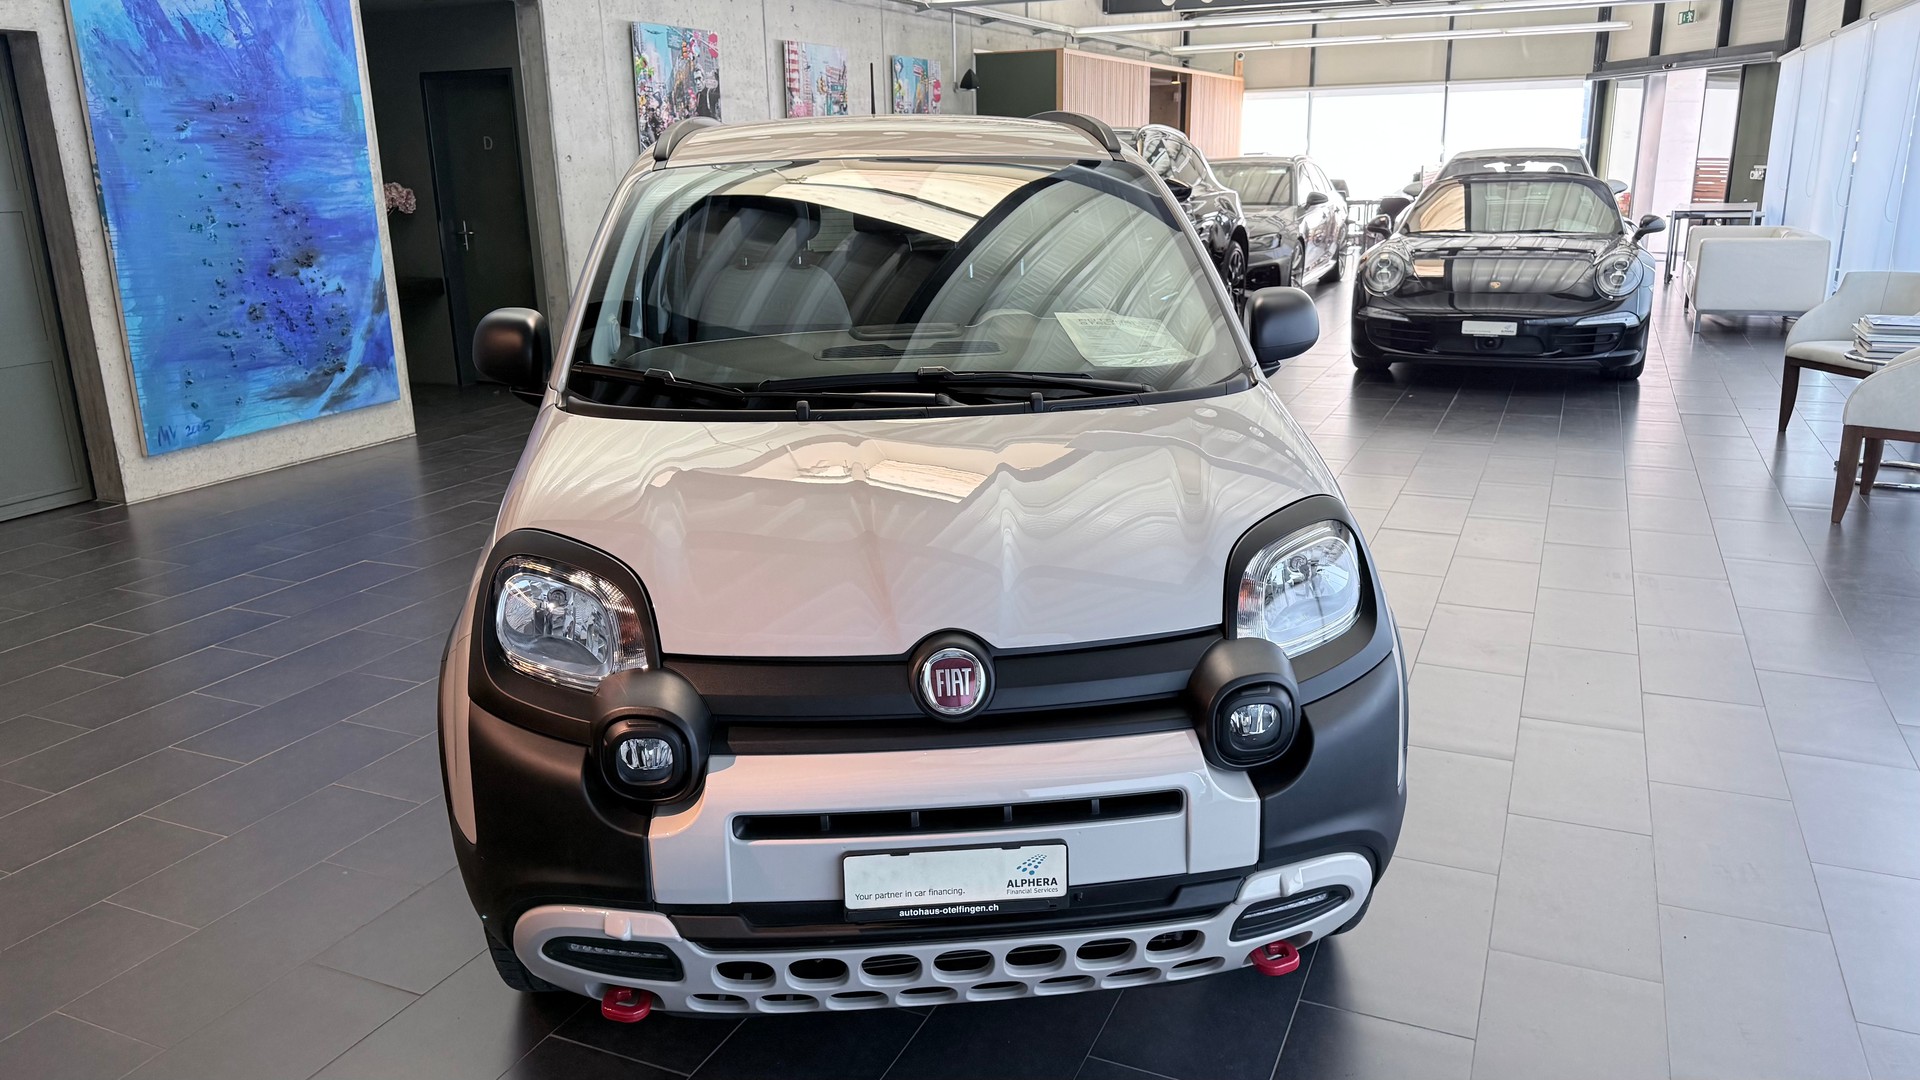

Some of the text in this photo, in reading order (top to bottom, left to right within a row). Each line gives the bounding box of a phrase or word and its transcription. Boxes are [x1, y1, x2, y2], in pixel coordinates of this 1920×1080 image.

[483, 135, 494, 150] D
[935, 667, 972, 698] FIAT
[1006, 877, 1059, 889] ALPHERA
[855, 887, 966, 901] Your partner in car financing.
[1006, 886, 1059, 896] Financial Services
[899, 903, 1000, 917] autohaus-otelfingen.ch
